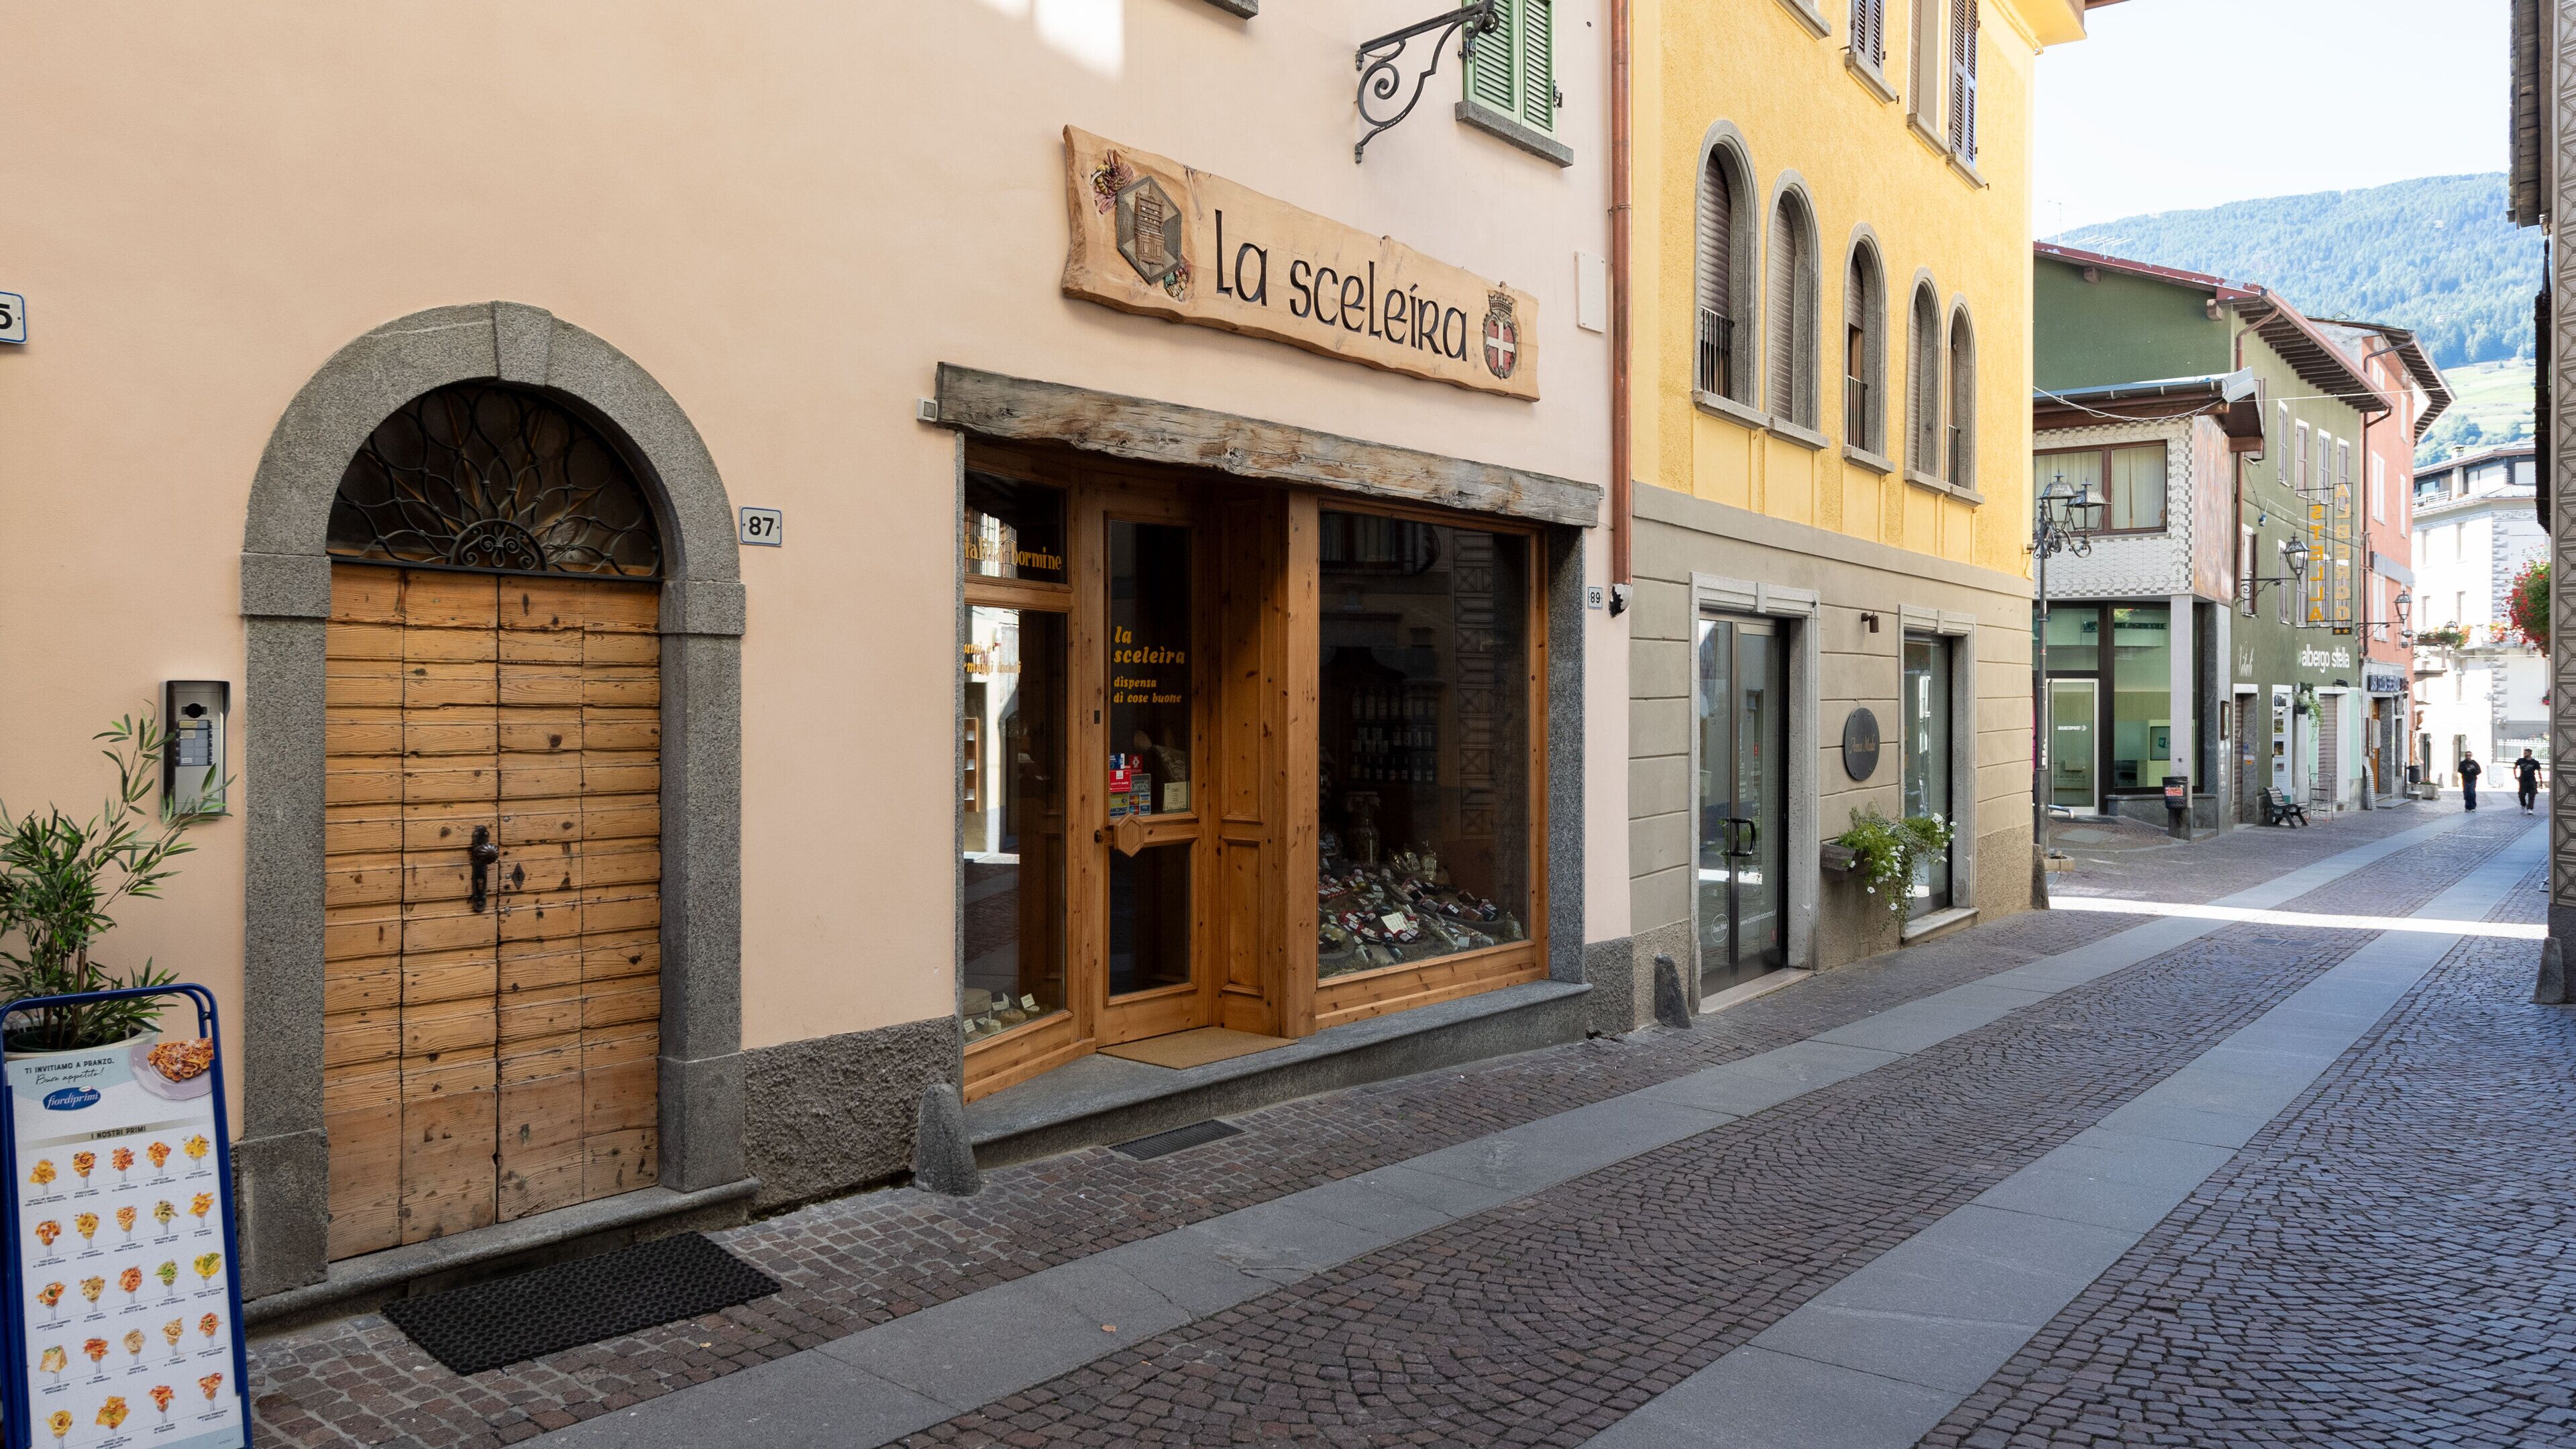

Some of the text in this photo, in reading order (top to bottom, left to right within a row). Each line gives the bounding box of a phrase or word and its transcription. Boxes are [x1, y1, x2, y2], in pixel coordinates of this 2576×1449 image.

[749, 516, 774, 536] 87
[1591, 592, 1601, 604] 89
[1114, 626, 1132, 643] la
[1114, 646, 1185, 664] sceleira
[2302, 644, 2349, 673] albergo stella
[1114, 676, 1157, 689] dispensa
[1114, 692, 1181, 703] di cose buone
[35, 1064, 73, 1073] INVITIAMO
[83, 1058, 115, 1067] PRANZO.
[36, 1067, 105, 1085] Buon appetito!
[46, 1092, 99, 1110] fiordiprimi
[97, 1129, 123, 1138] NOSTRI
[126, 1126, 146, 1134] PRIMI
